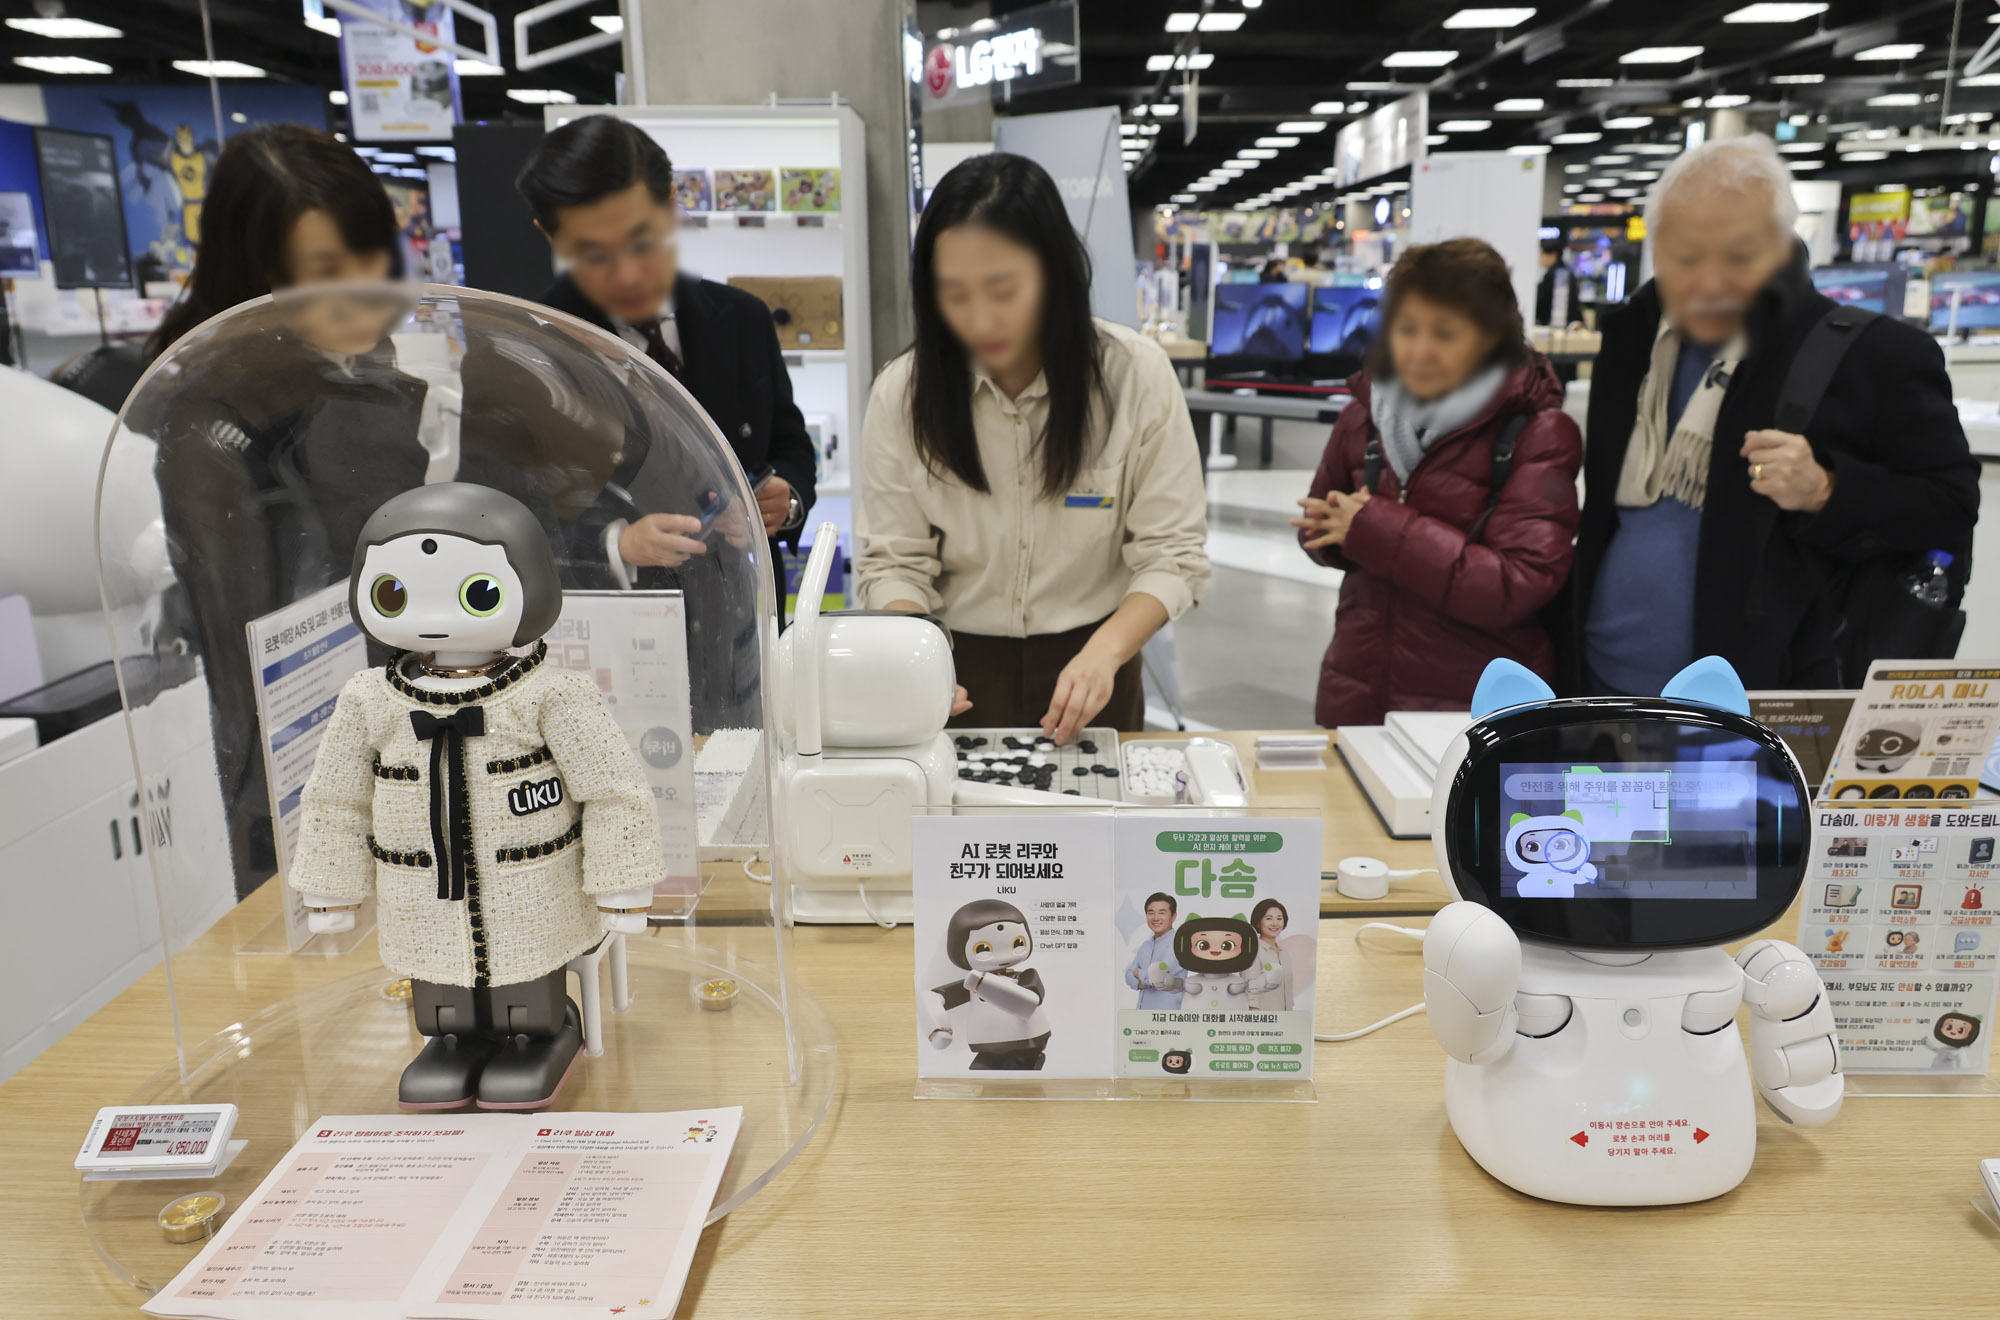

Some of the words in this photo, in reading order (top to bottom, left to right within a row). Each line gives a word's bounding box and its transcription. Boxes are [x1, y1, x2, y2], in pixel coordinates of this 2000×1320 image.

[265, 633, 280, 654] 로봇
[1890, 683, 1945, 699] ROLA
[1952, 683, 1988, 699] 미니
[1521, 781, 1555, 793] 안전을
[1557, 781, 1580, 793] 위해
[1584, 781, 1618, 793] 주위를
[1621, 781, 1654, 793] 꼼꼼히
[1659, 781, 1681, 793] 확인
[1820, 814, 1858, 827] 다솜이,
[1864, 814, 1899, 827] 이렇게
[1904, 814, 1941, 827] 생활을
[961, 843, 981, 859] AI
[985, 843, 1011, 859] 로봇
[1017, 843, 1058, 859] 리쿠와
[1193, 843, 1201, 851] AI
[1203, 843, 1216, 851] 인지
[1218, 843, 1232, 851] 케어
[1233, 843, 1246, 851] 로봇
[950, 863, 991, 879] 친구가
[996, 863, 1064, 879] 되어보세요
[1832, 870, 1858, 878] 체조코너
[1898, 870, 1926, 878] 퀴즈코너
[1968, 870, 1989, 878] 자서전
[1175, 858, 1257, 898] 다솜
[1040, 915, 1056, 923] 다양한
[1828, 915, 1850, 923] 일기장
[1848, 982, 1877, 992] 부모님도
[1880, 982, 1895, 992] 저도
[1898, 982, 1922, 992] 안심할
[1925, 982, 1932, 992] 수
[1935, 982, 1973, 992] 있을까요?
[1151, 1014, 1167, 1023] 지금
[1169, 1014, 1200, 1023] 다솜이와
[1202, 1014, 1226, 1023] 대화를
[1228, 1014, 1278, 1023] 시작해보세요!
[1590, 1121, 1612, 1129] 이동시
[1616, 1121, 1646, 1129] 양손으로
[1649, 1121, 1664, 1129] 안아
[1667, 1119, 1691, 1127] 주세요.
[115, 1129, 137, 1138] 신세계
[1613, 1134, 1627, 1142] 로봇
[1631, 1134, 1645, 1142] 손과
[1648, 1134, 1670, 1142] 머리를
[110, 1138, 131, 1146] 포인트
[1608, 1147, 1630, 1156] 당기지
[1633, 1147, 1648, 1156] 말아
[1652, 1147, 1676, 1156] 주세요.
